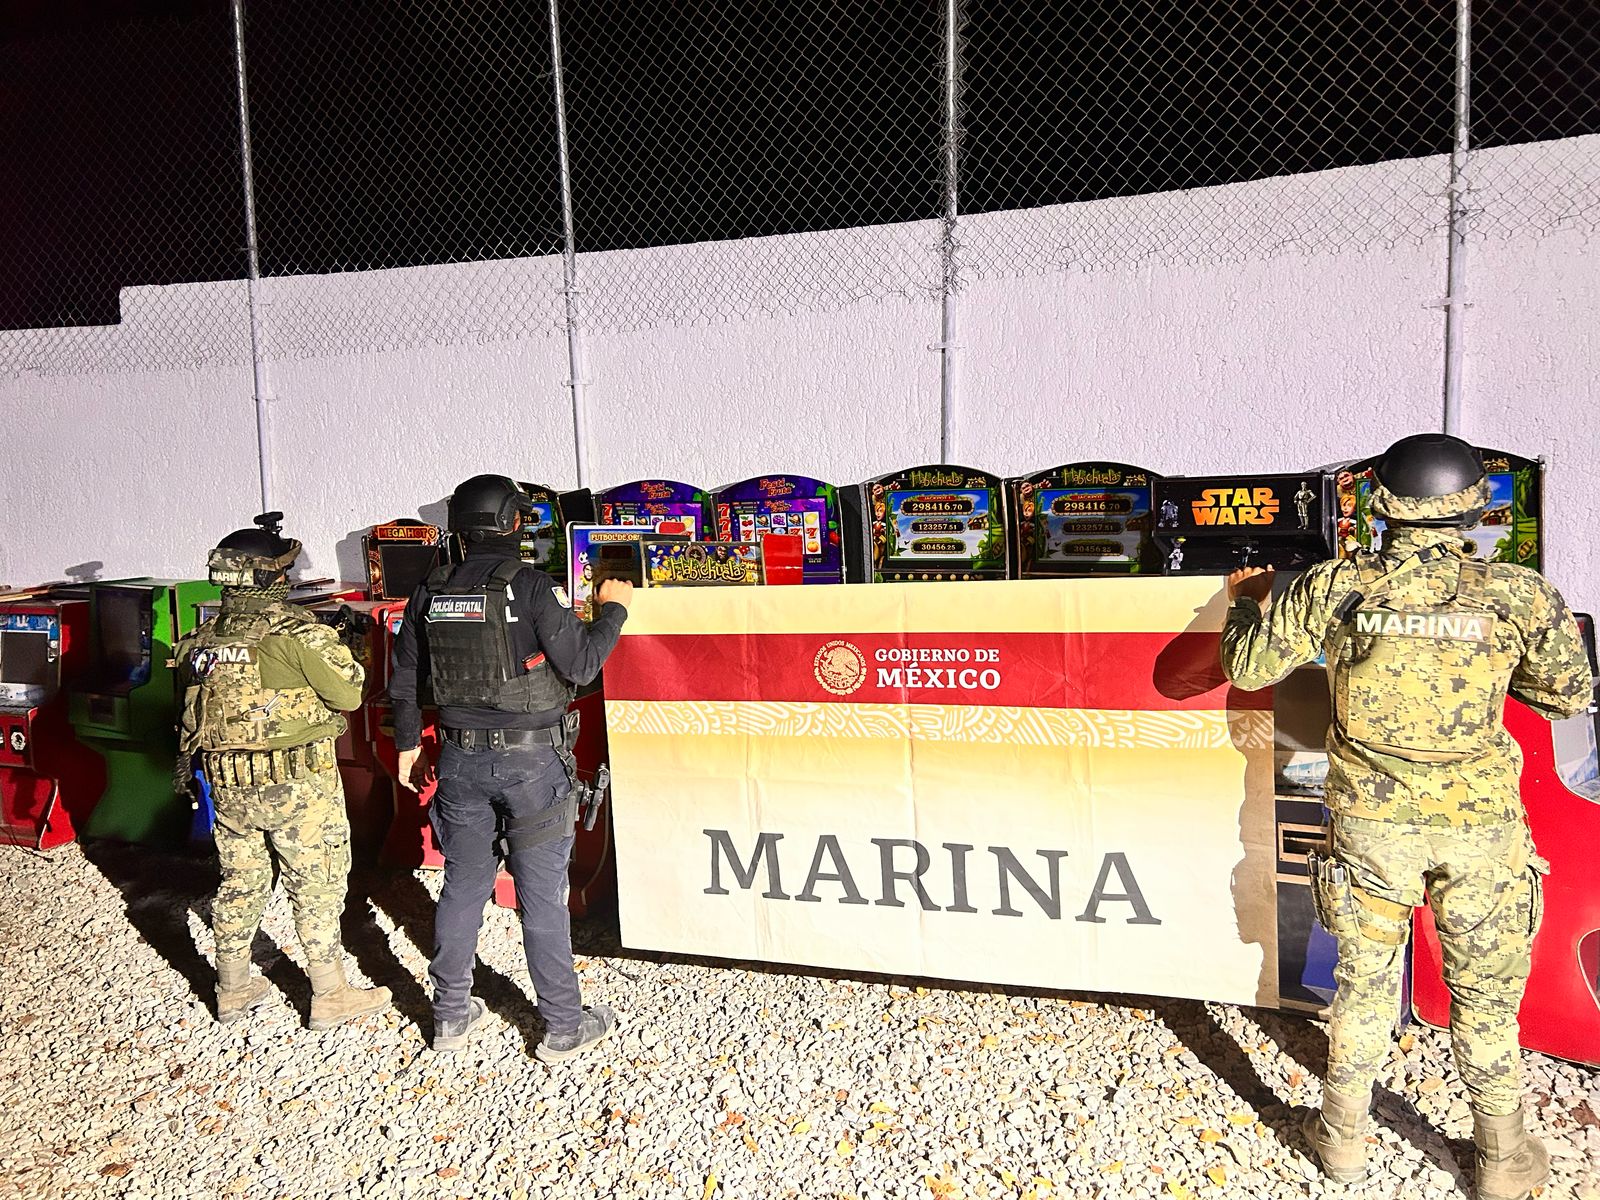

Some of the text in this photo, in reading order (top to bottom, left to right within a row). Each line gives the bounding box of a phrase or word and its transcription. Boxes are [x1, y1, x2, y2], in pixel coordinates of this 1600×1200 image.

[1191, 487, 1280, 507] STAR
[912, 502, 963, 511] 298416.70
[1064, 501, 1120, 511] 298416.70
[1191, 506, 1280, 526] WARS
[380, 528, 436, 538] MEGA HOT 9
[919, 523, 957, 531] 123257.51
[921, 543, 956, 551] 30456.25
[668, 556, 748, 581] Habichuelas
[431, 599, 483, 613] POLICÍA ESTATAL
[1356, 612, 1484, 640] MARINA
[874, 648, 1000, 663] GOBIERNO DE
[876, 662, 1001, 690] MÉXICO
[702, 828, 1163, 926] MARINA
